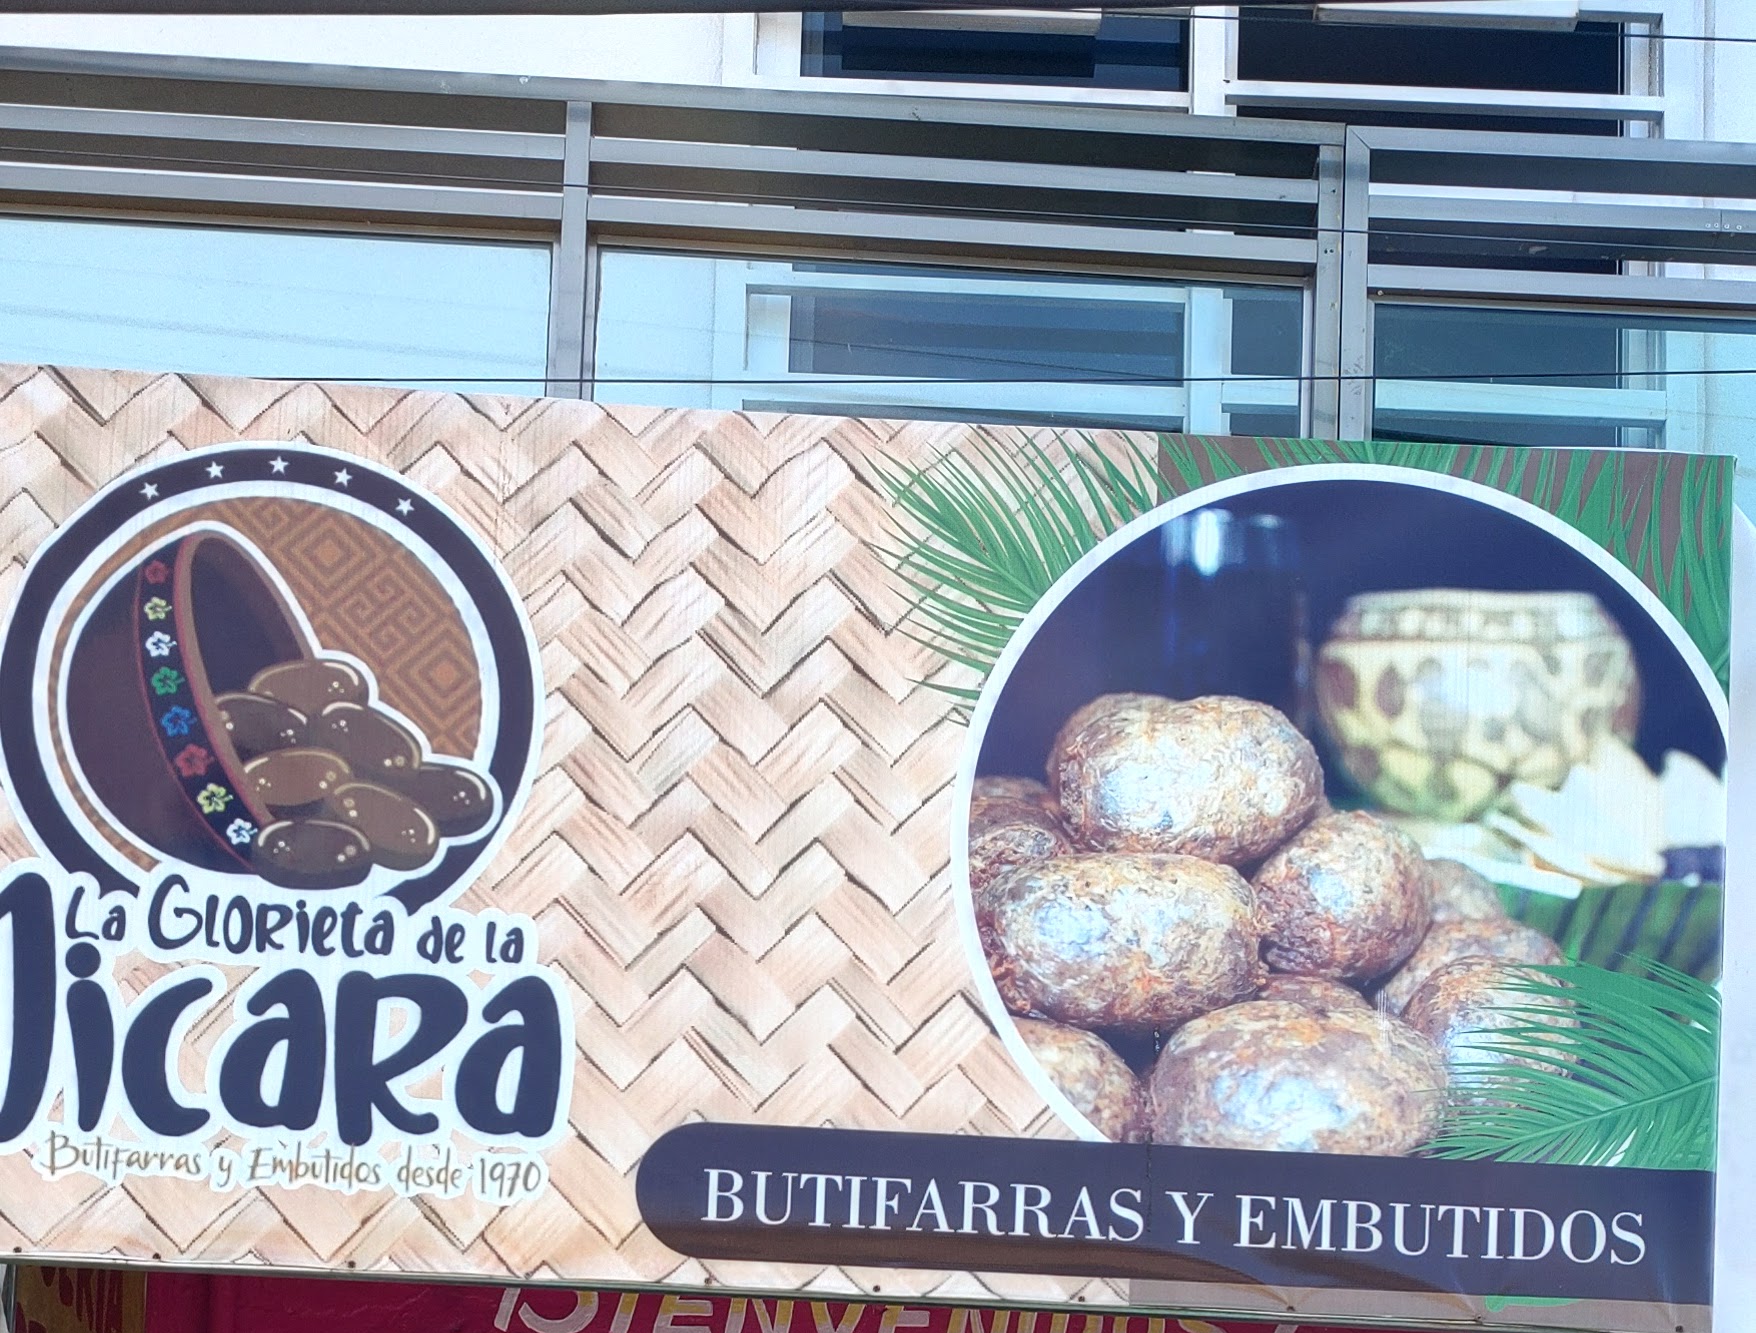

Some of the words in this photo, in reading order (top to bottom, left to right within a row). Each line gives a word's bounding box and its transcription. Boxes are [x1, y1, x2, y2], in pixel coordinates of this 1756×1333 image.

[65, 885, 126, 942] La
[416, 915, 465, 964] de
[485, 919, 525, 964] la
[40, 1129, 202, 1180] Butifarras
[218, 1153, 232, 1188] y
[249, 1140, 381, 1189] Embutidos
[397, 1144, 463, 1194] desde
[479, 1157, 541, 1198] 1970
[701, 1168, 1145, 1242] BUTIFARRAS
[1165, 1190, 1214, 1244] Y
[1233, 1194, 1647, 1266] EMBUTIDOS
